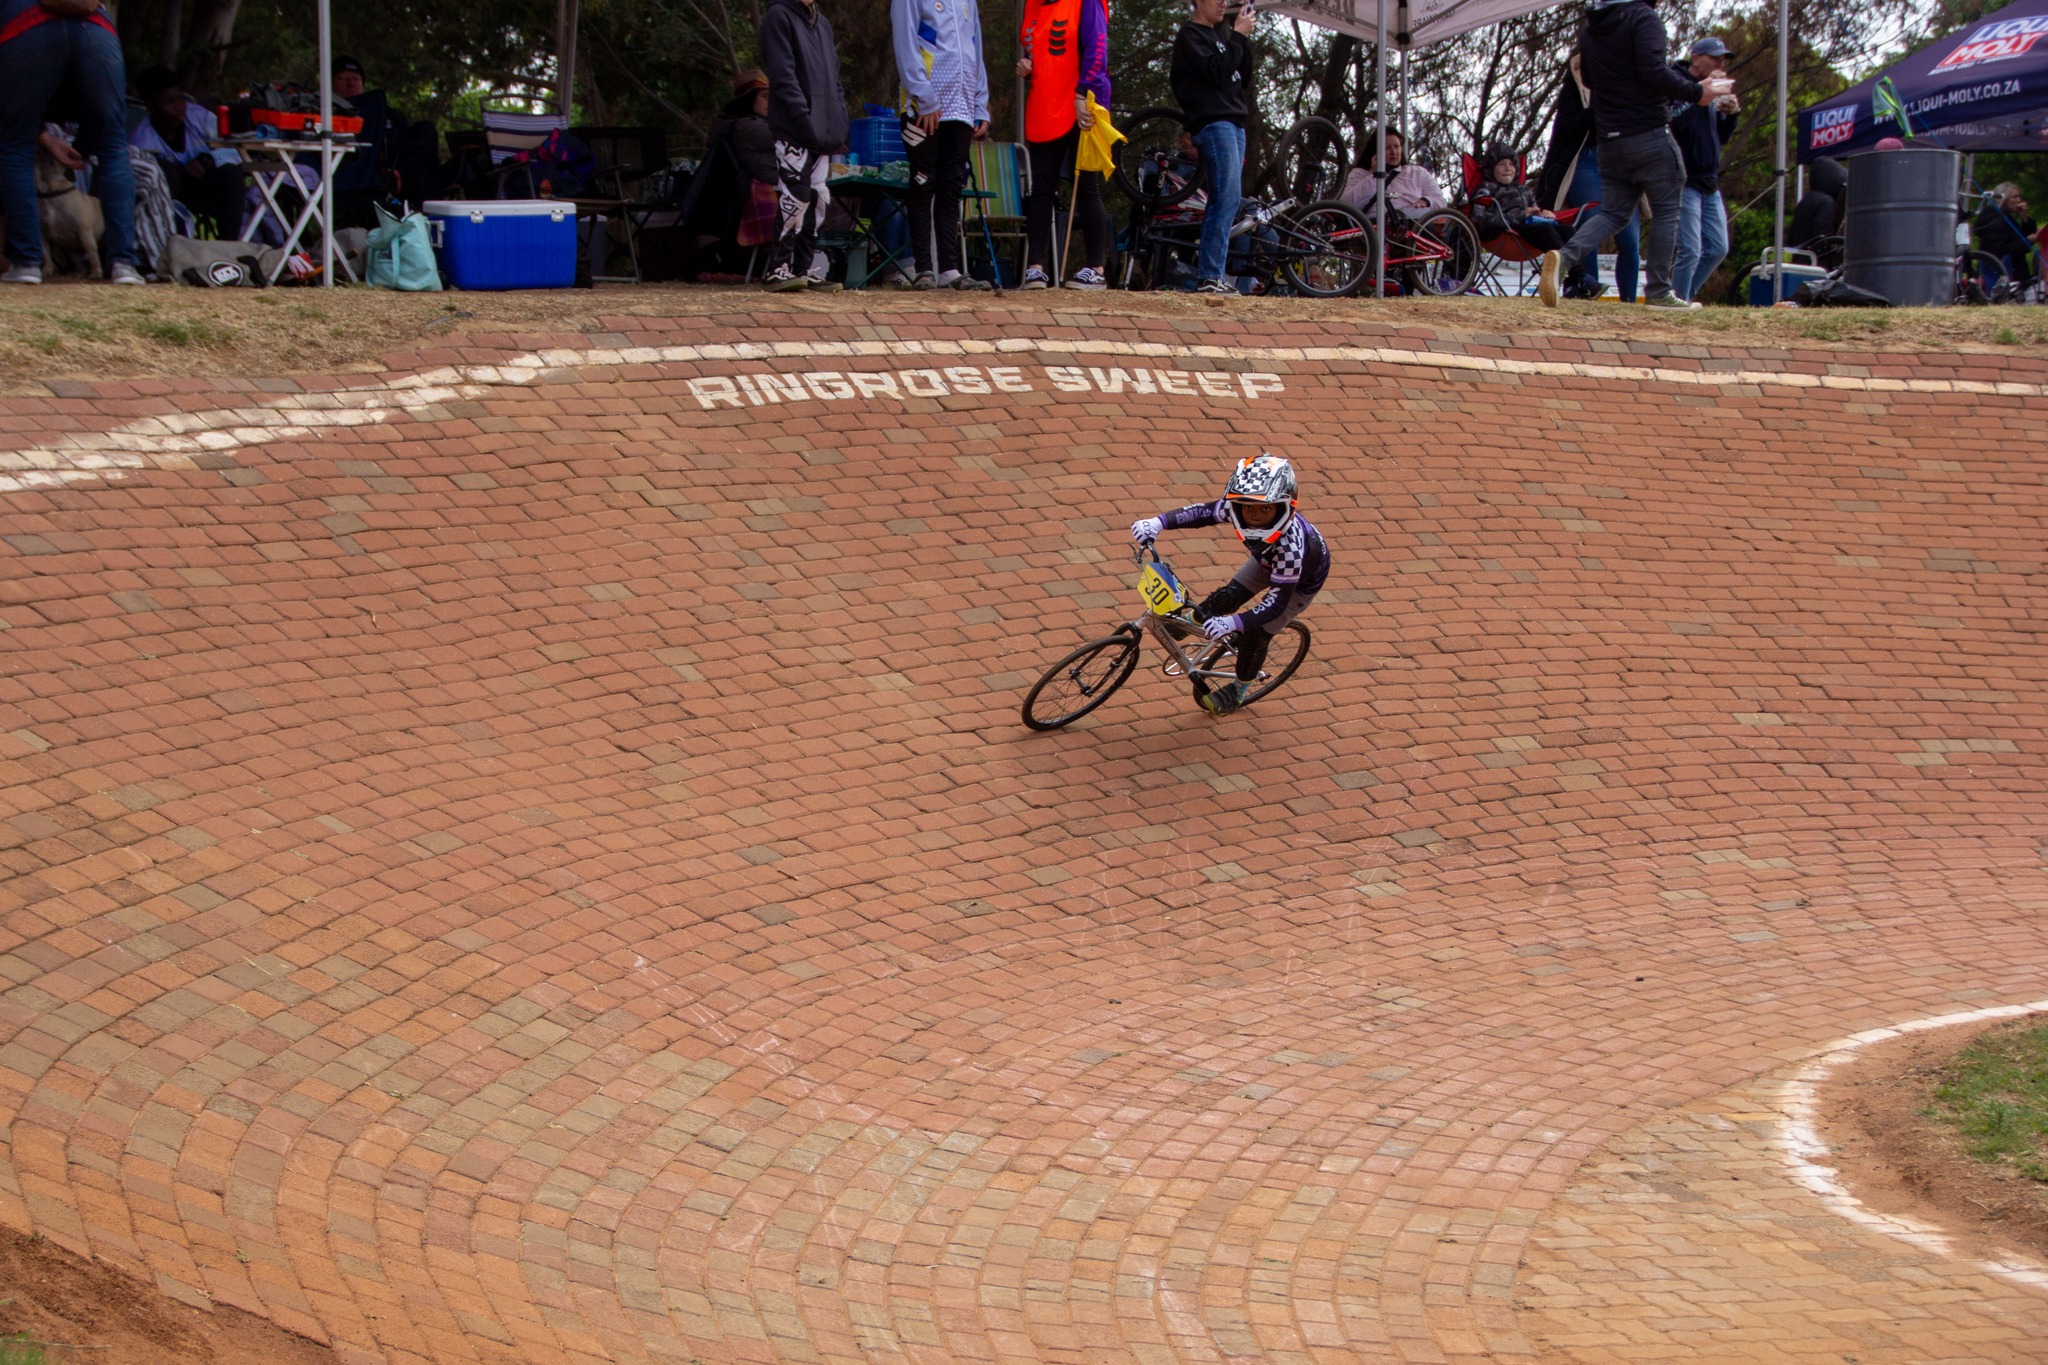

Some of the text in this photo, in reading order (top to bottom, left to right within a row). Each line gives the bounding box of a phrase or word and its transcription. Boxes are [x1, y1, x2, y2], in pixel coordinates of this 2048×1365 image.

[1944, 32, 2045, 65] MOLY
[1813, 106, 1854, 128] LIQUI
[1873, 79, 2021, 126] WW.LIQUI-MOLY.CO.ZA
[1812, 122, 1852, 147] MOLY
[685, 365, 1286, 409] RINGROSE SWEEP
[1144, 577, 1170, 606] 30
